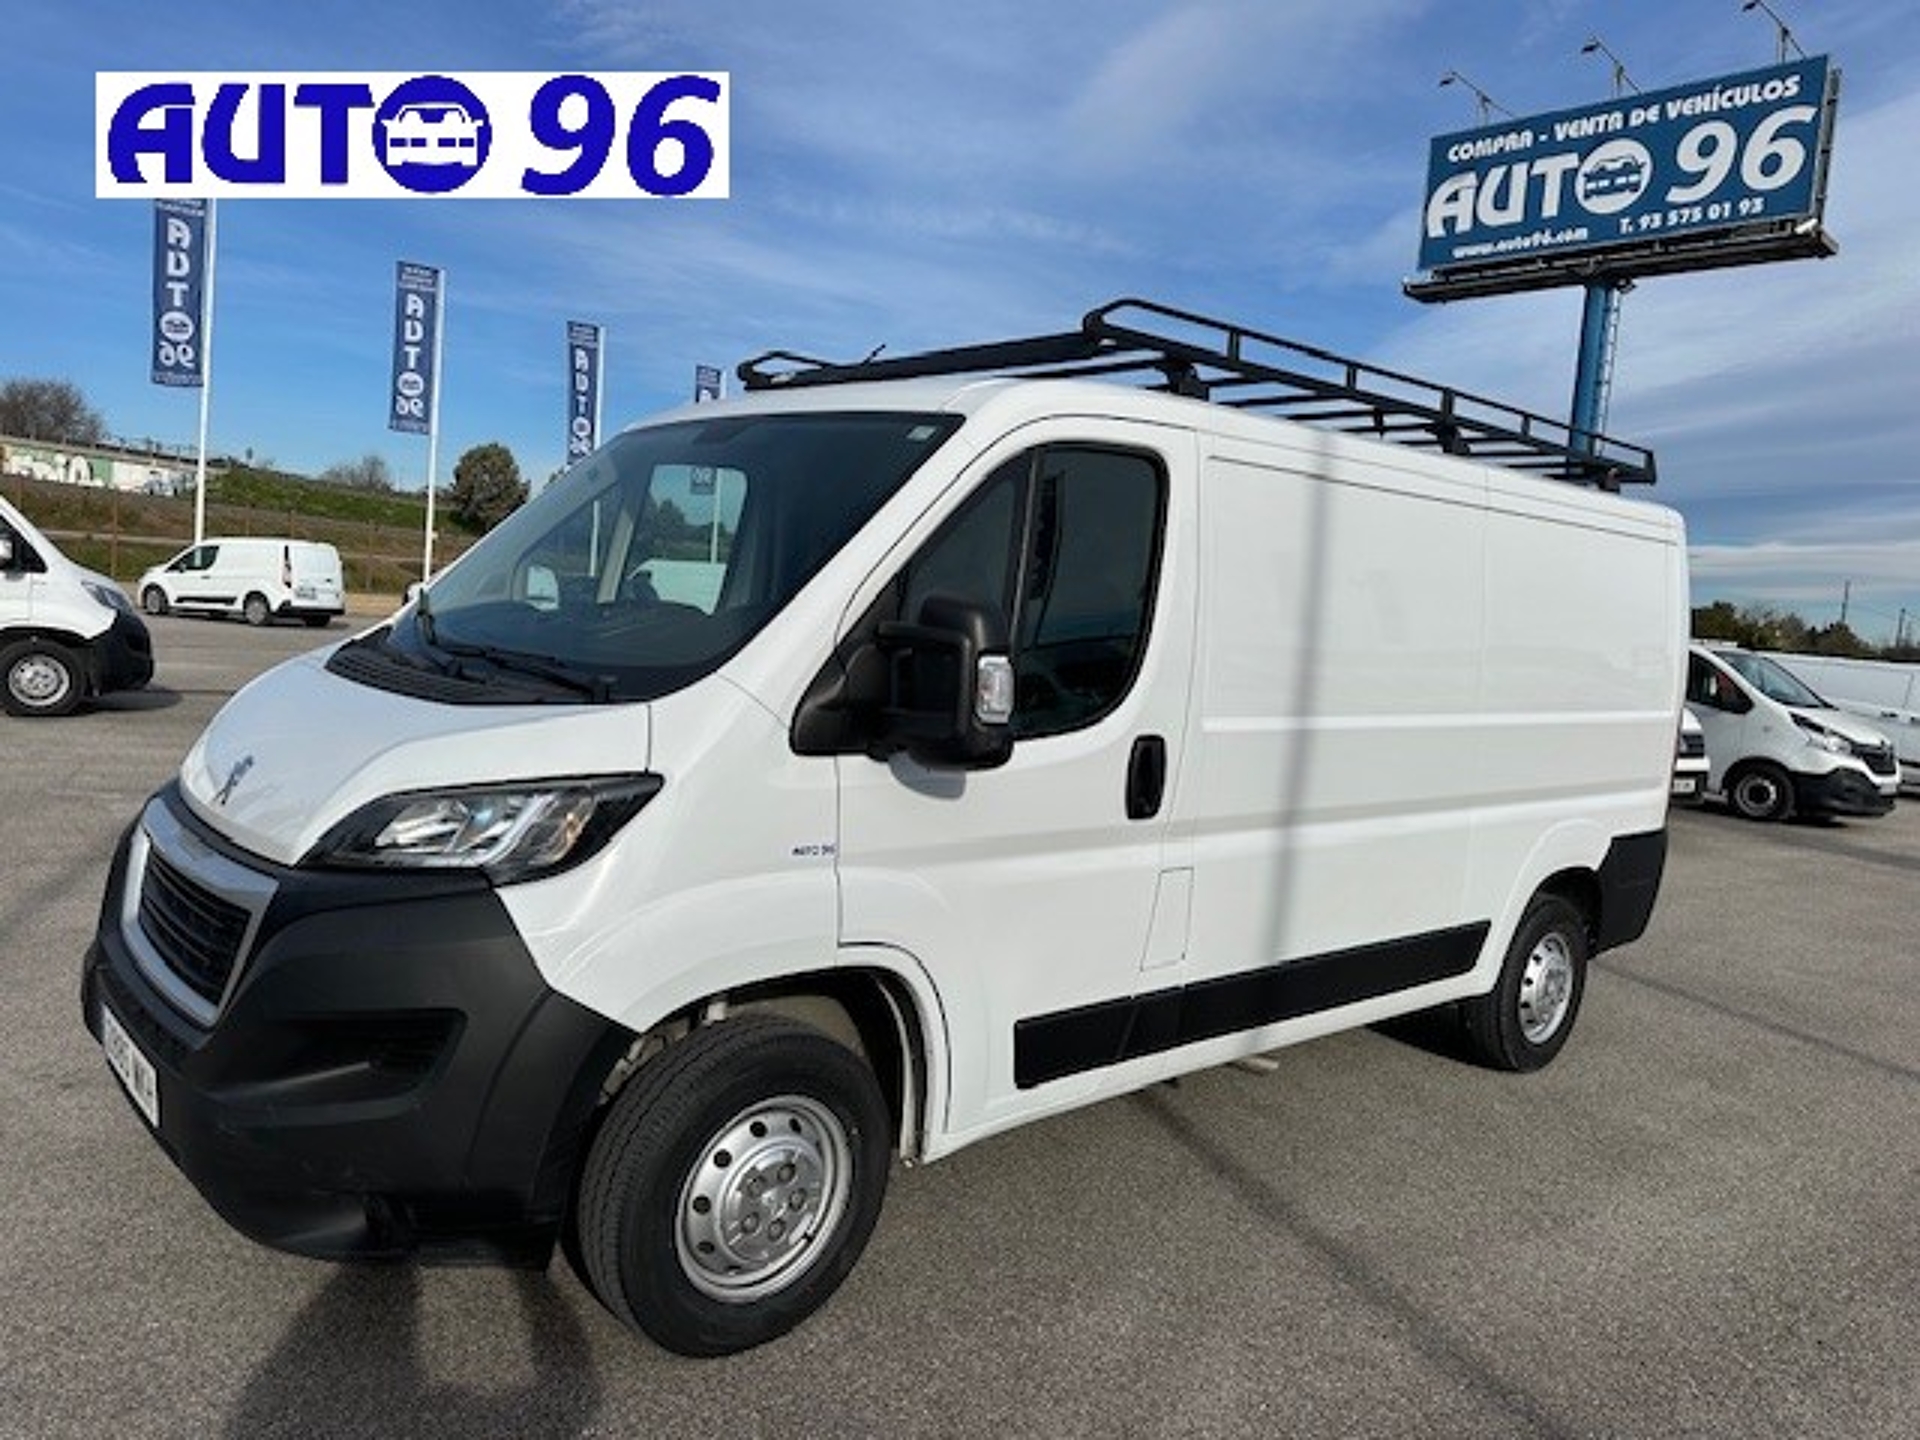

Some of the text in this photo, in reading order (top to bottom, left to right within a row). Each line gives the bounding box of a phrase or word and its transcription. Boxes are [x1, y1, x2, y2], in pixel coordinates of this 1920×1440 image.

[1447, 129, 1534, 163] COMPRA
[1553, 111, 1624, 142] VENTA
[1628, 104, 1661, 128] DE
[1666, 74, 1801, 120] VEHÍCULOS
[1426, 106, 1818, 238] AUTO 96
[1707, 202, 1732, 220] 01
